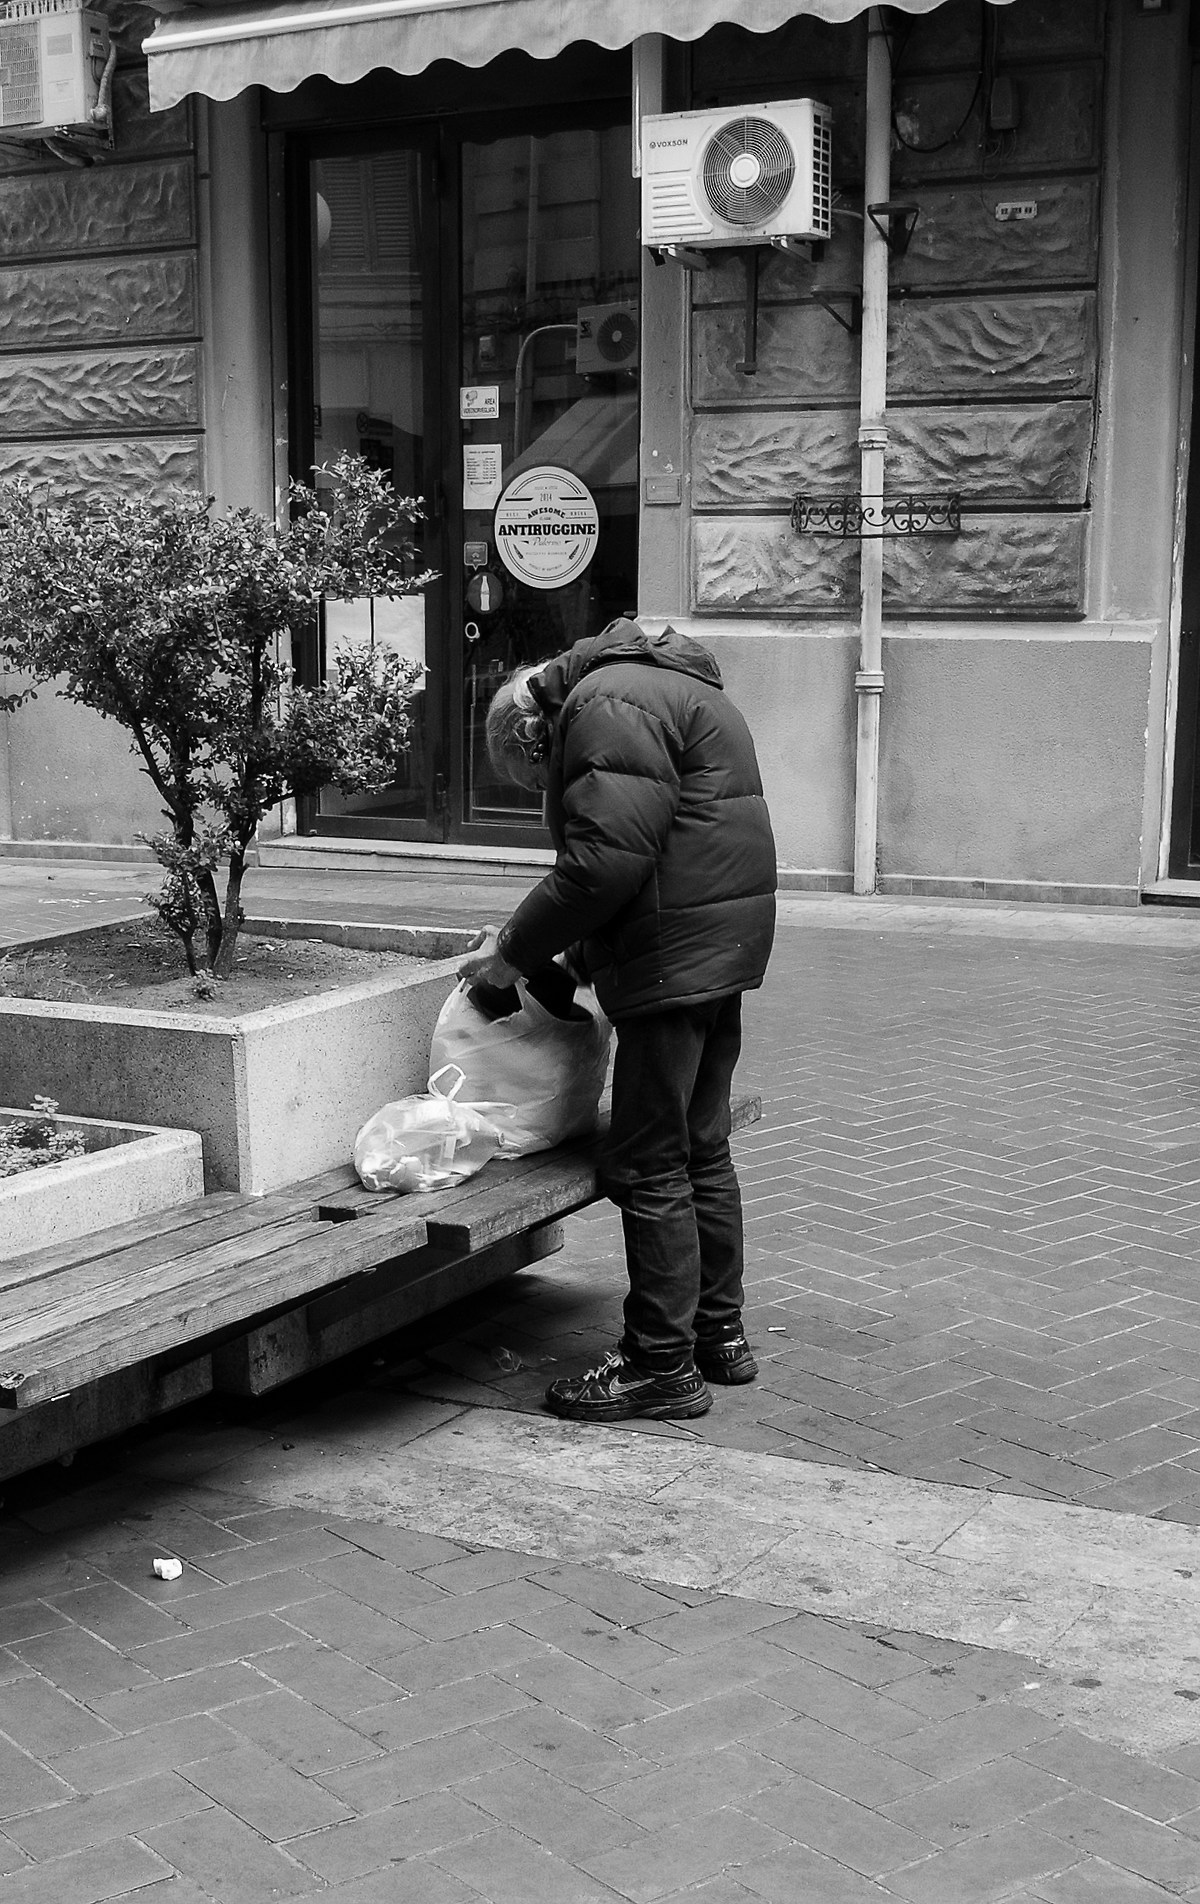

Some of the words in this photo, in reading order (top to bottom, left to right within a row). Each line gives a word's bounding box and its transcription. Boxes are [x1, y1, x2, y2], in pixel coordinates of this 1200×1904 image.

[657, 139, 688, 148] VOXSON
[527, 507, 566, 519] AWESOME
[498, 523, 596, 536] ANTIRUGGINE
